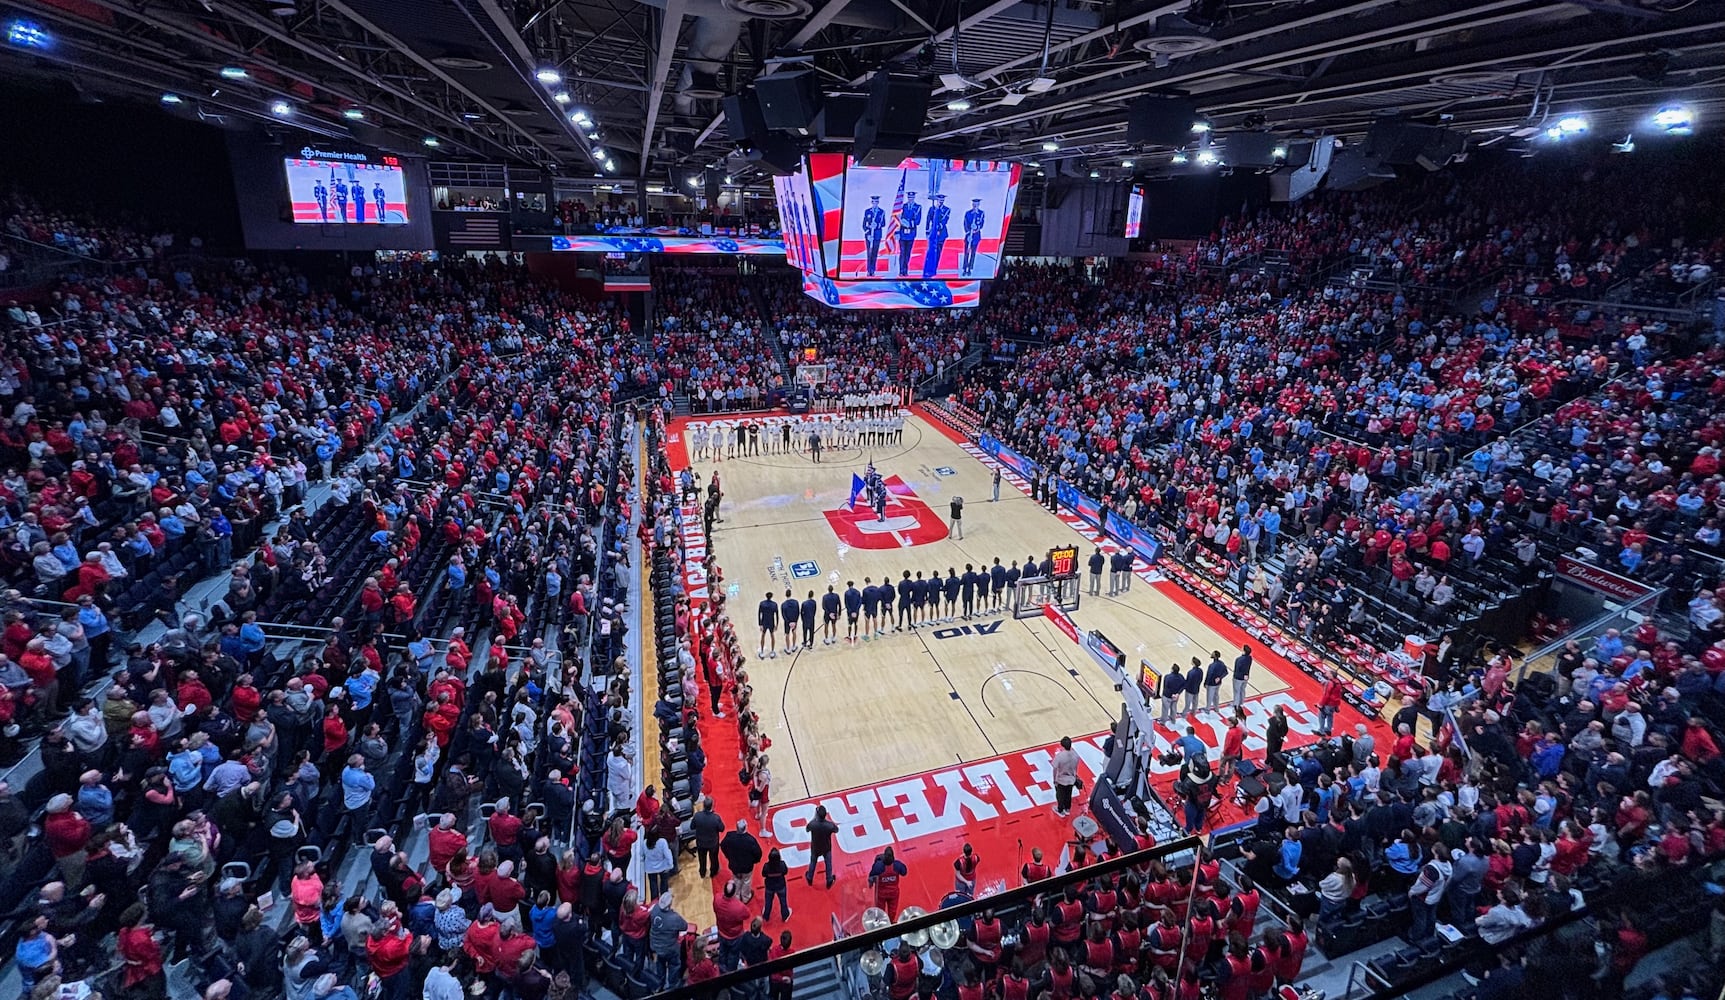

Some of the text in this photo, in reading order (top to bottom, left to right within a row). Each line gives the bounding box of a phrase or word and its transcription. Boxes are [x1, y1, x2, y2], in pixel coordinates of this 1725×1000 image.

[315, 150, 367, 161] Premier Health
[958, 441, 1036, 498] UNIVERSIT
[1052, 549, 1075, 561] 20:00
[1053, 558, 1071, 574] 30
[1566, 563, 1643, 597] Budweiser
[772, 750, 1080, 868] FLYERS
